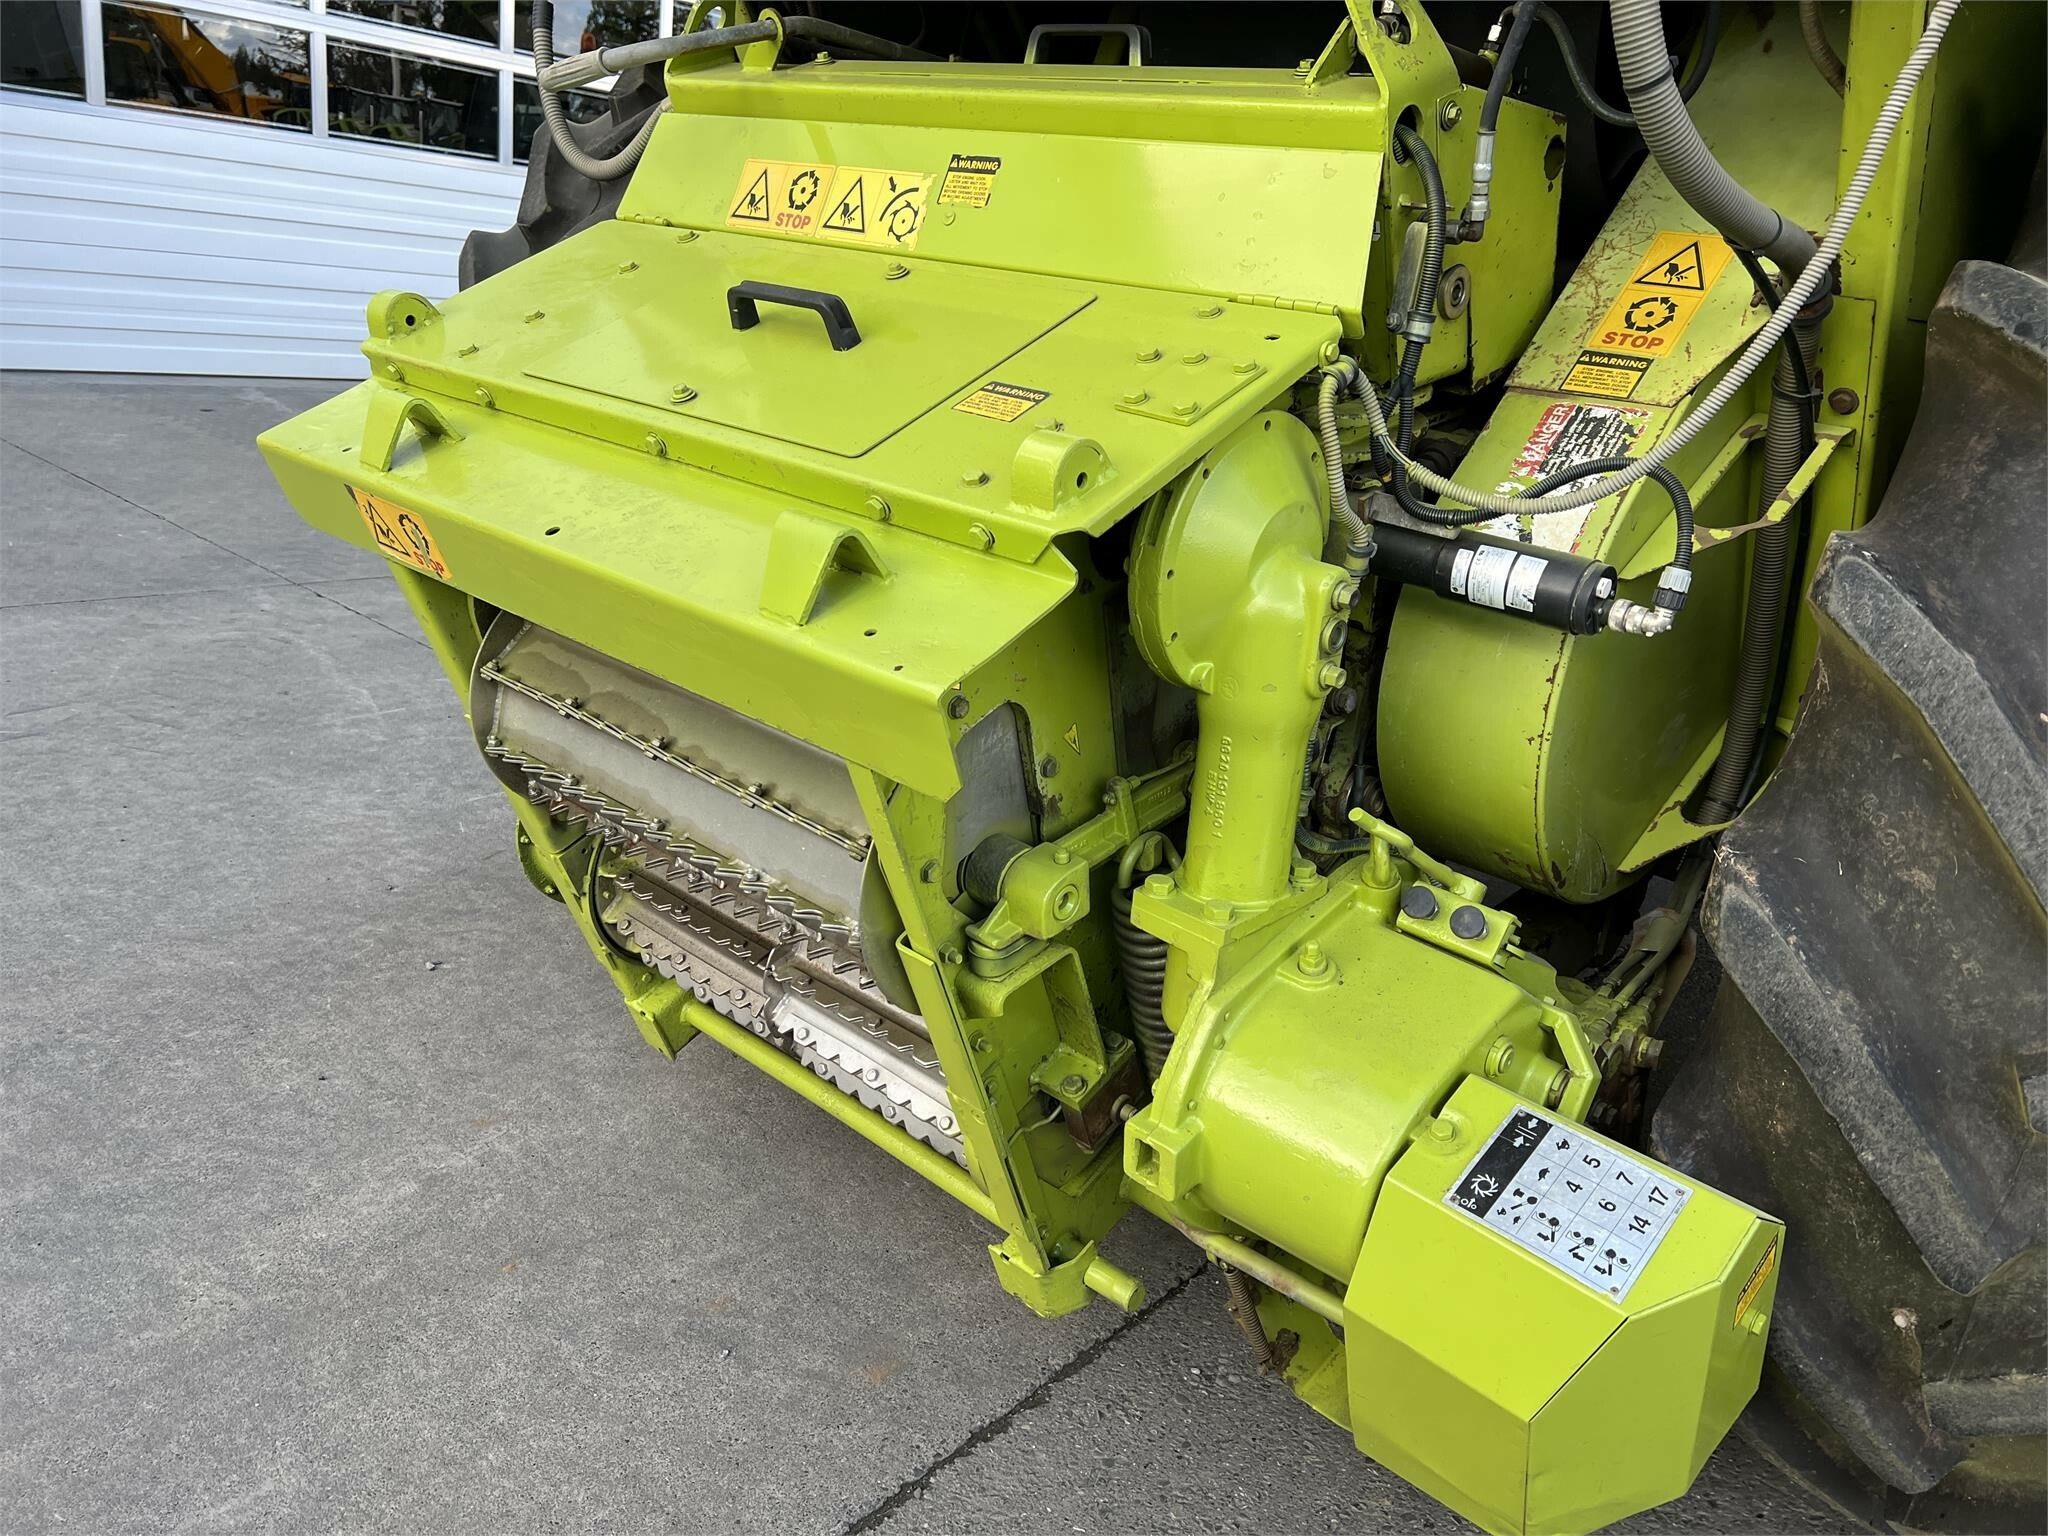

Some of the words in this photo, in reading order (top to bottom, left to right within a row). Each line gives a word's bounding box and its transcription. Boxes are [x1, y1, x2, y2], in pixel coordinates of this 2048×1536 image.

[958, 160, 999, 170] WARNING
[775, 212, 811, 230] STOP
[1602, 332, 1664, 350] STOP
[1591, 355, 1648, 369] WARNING
[994, 385, 1046, 400] WARNING
[1566, 1180, 1583, 1193] 4
[1582, 1155, 1601, 1168] 5
[1598, 1199, 1616, 1212] 6
[1616, 1171, 1633, 1185] 7
[1628, 1215, 1651, 1234] 14
[1648, 1186, 1668, 1206] 17
